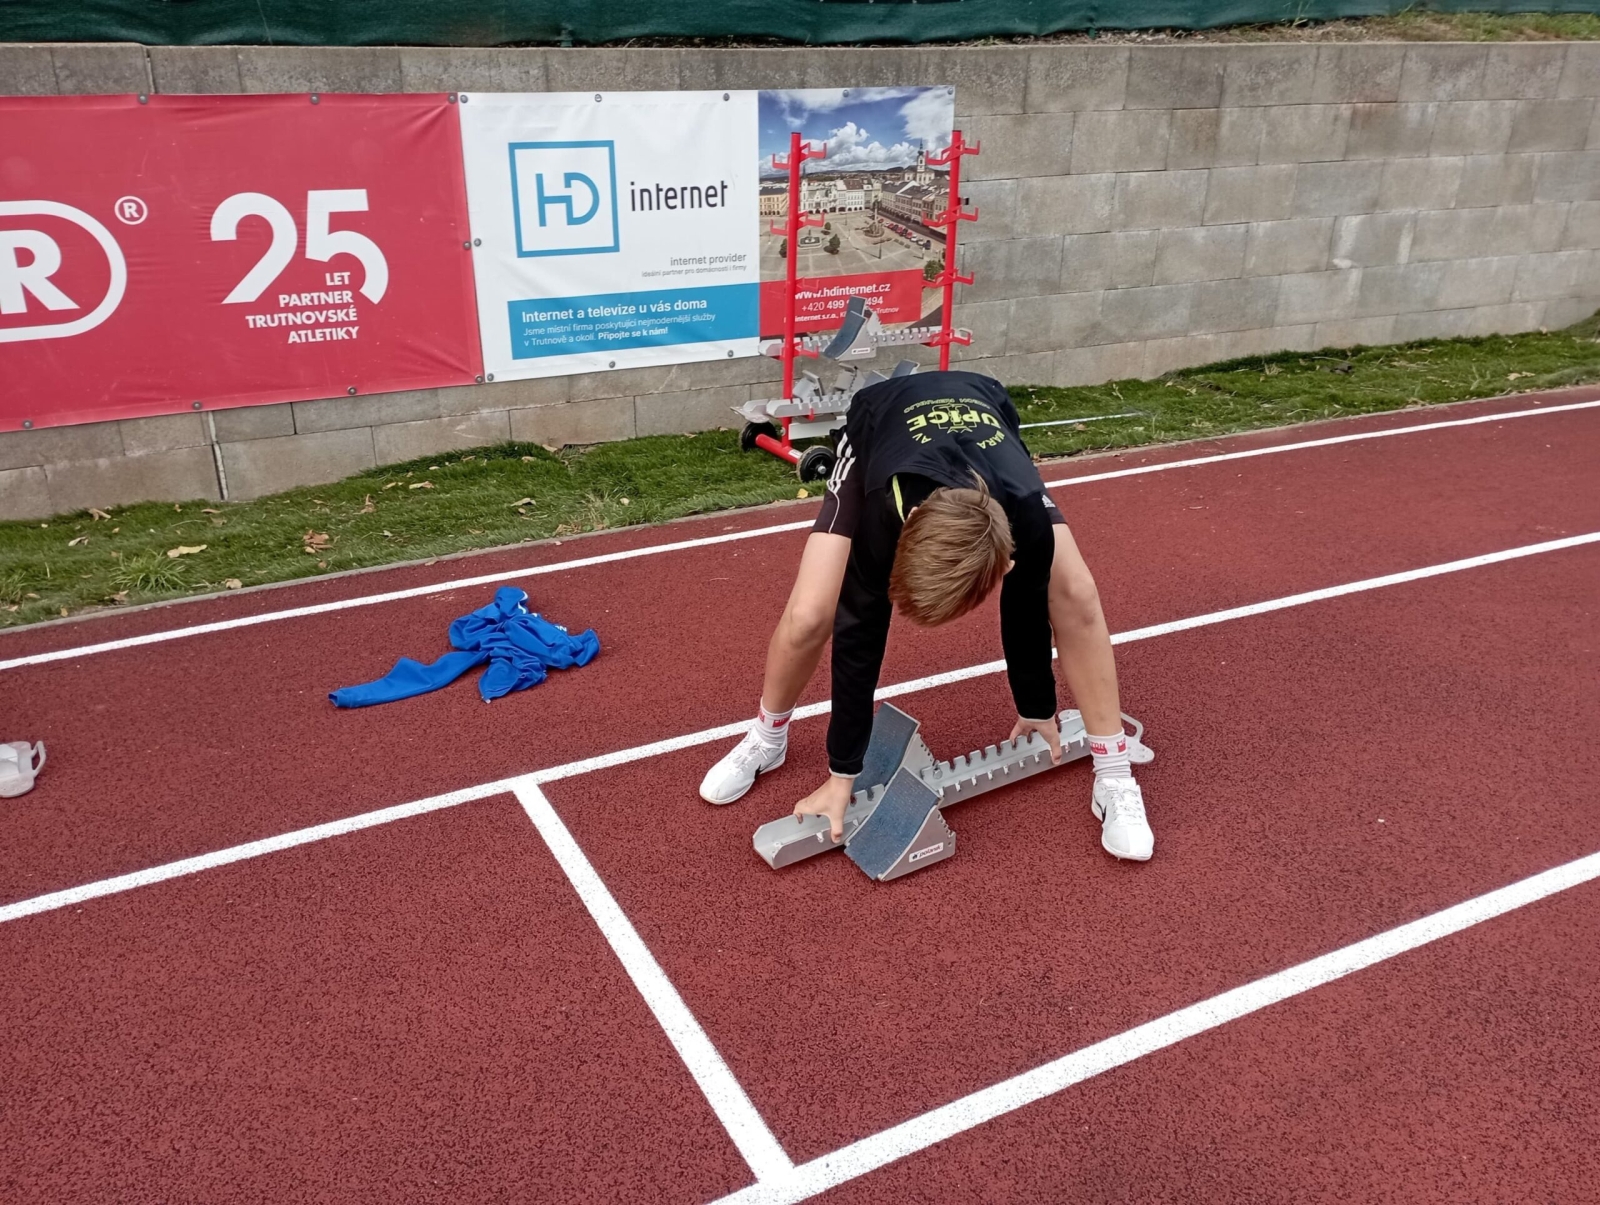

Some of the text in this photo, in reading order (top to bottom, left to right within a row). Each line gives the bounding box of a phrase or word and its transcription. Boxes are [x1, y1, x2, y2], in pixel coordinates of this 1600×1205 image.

[535, 172, 728, 227] HD internet
[210, 189, 389, 305] 25
[670, 253, 747, 267] internet provider
[325, 271, 351, 286] LET
[278, 290, 354, 308] PARTNER
[802, 301, 825, 312] +420
[826, 299, 845, 310] 499
[245, 305, 358, 329] TRUTNOVSKÉ
[522, 299, 708, 323] Internet a televize u vás doma
[523, 312, 716, 336] Jsme místní firma poskytující nejmodernější služby
[287, 326, 360, 344] ATLETIKY
[531, 334, 567, 347] Trutnově
[598, 329, 630, 342] Připojte
[632, 330, 641, 338] se
[642, 328, 648, 336] k
[649, 326, 669, 337] nám!
